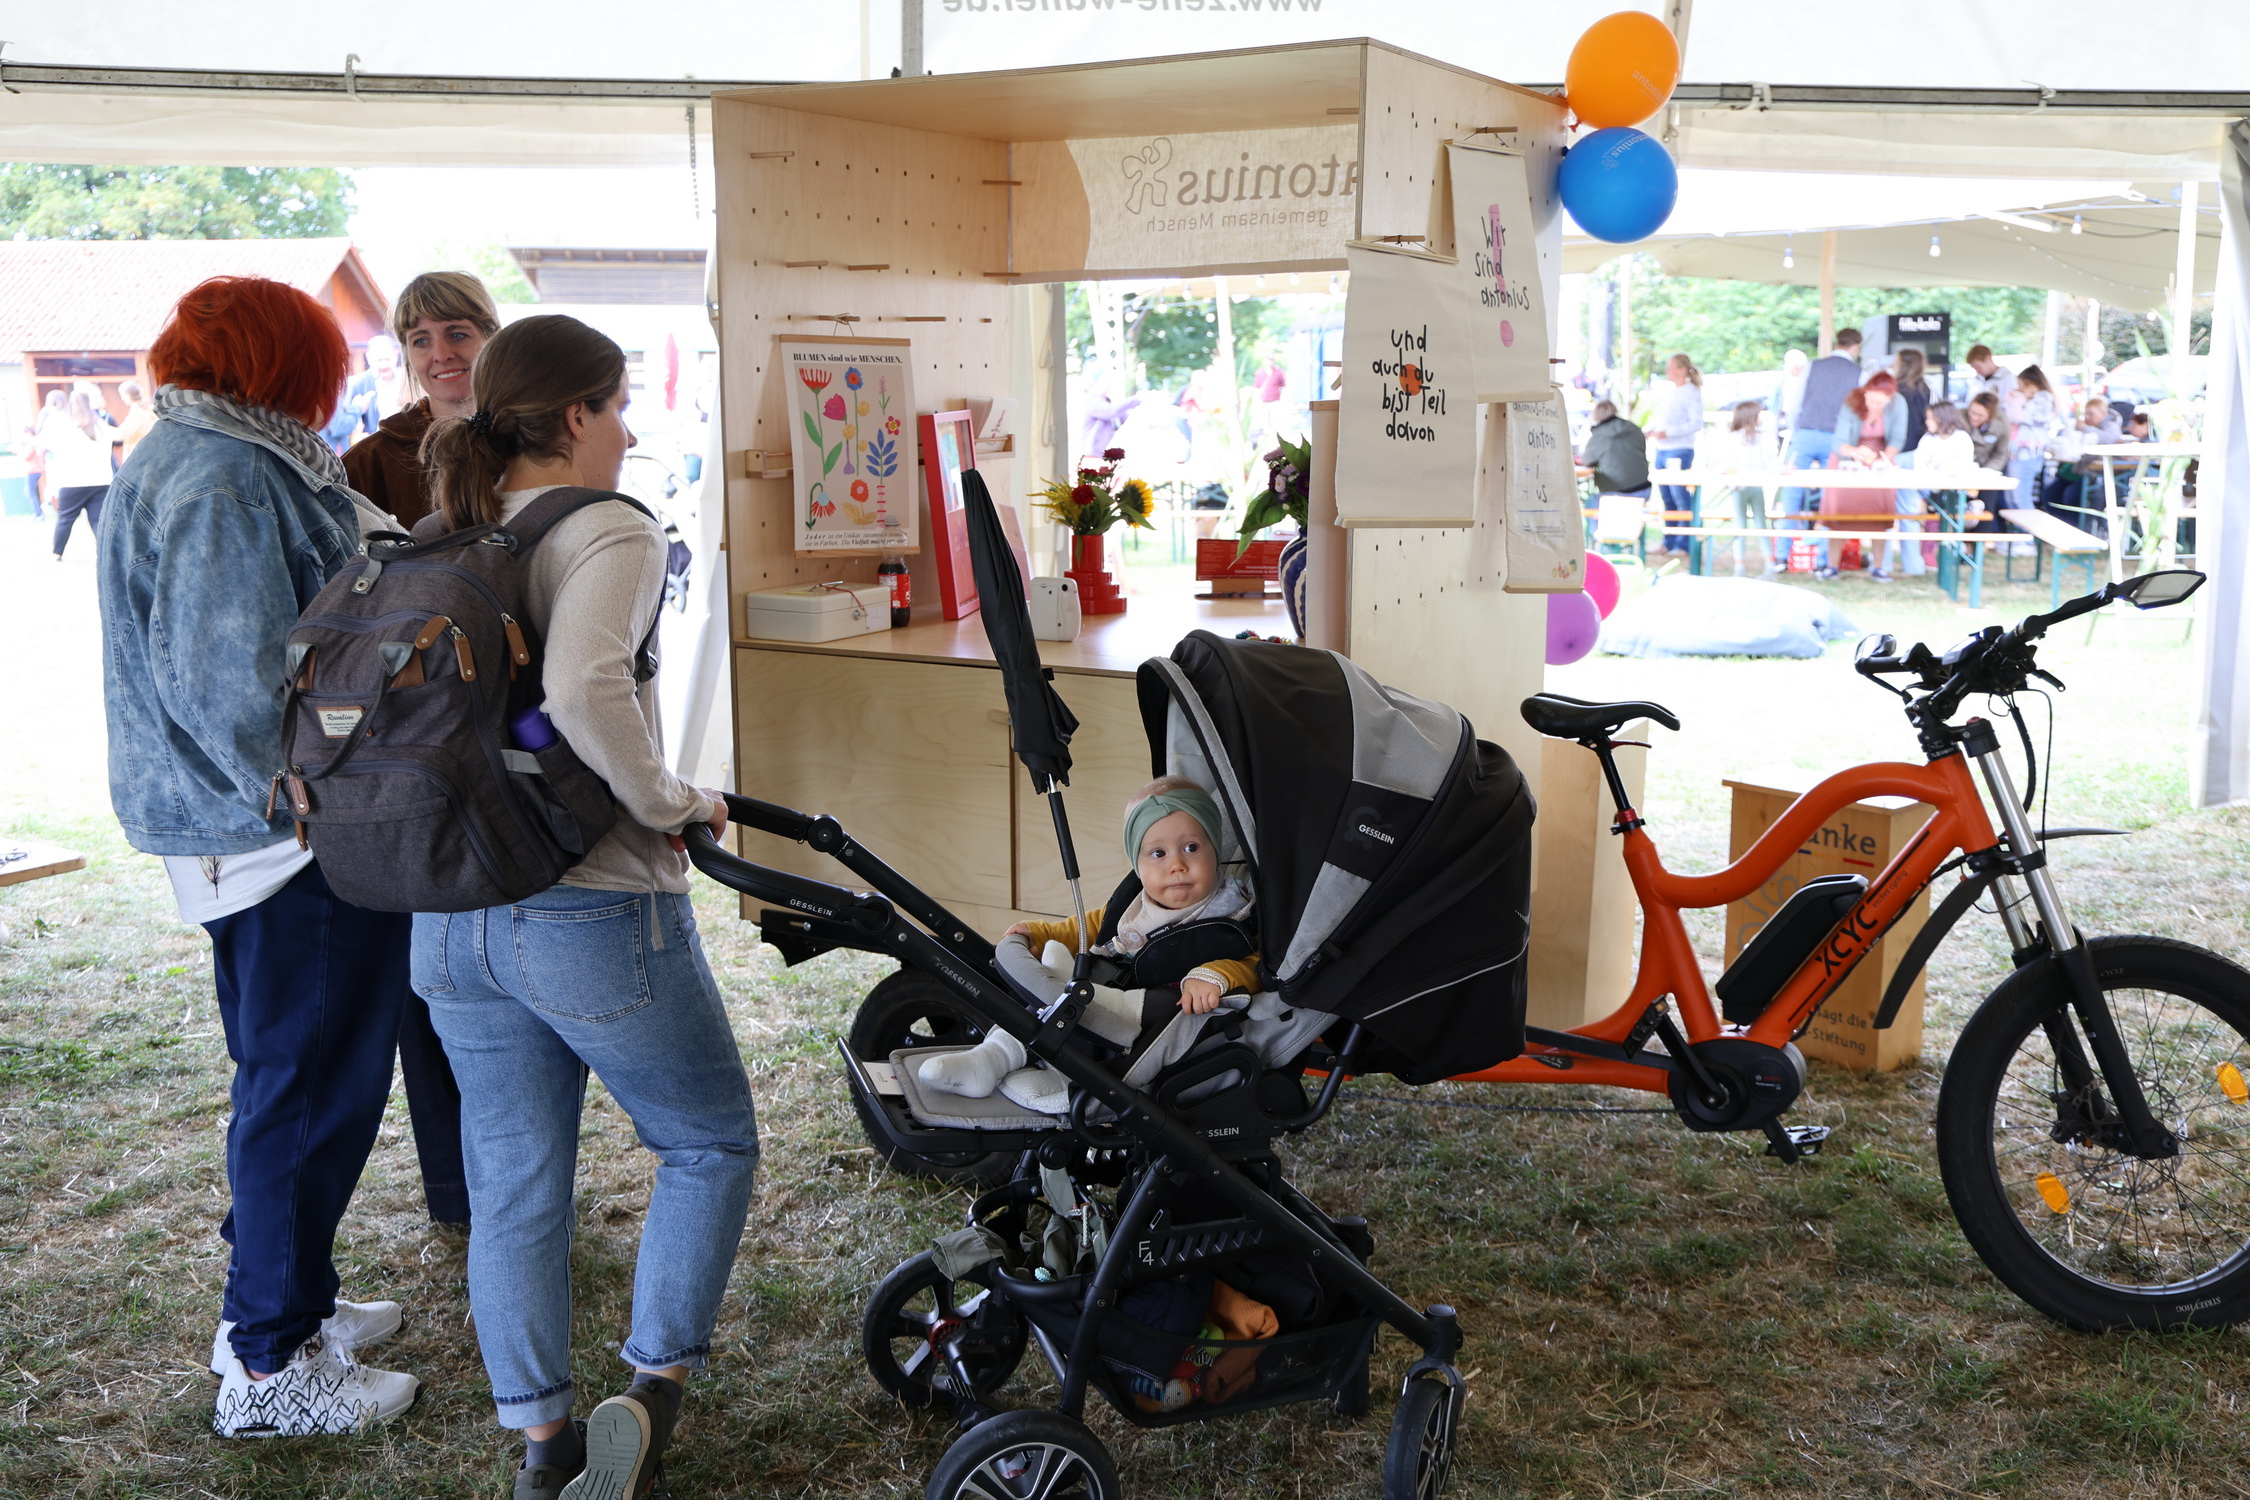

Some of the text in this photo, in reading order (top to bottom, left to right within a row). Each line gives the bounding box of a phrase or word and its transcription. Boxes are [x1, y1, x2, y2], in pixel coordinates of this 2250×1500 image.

[1481, 215, 1506, 249] Wir
[793, 353, 827, 361] BLUMEN
[827, 354, 843, 362] sind
[1372, 348, 1434, 383] auch du
[1382, 383, 1446, 415] bist Teil
[1386, 412, 1435, 442] davon
[1528, 425, 1556, 450] anton
[1359, 824, 1395, 845] GESSLEIN
[1808, 823, 1876, 855] nke
[789, 898, 833, 917] GESSLEIN
[1815, 905, 1878, 978] XCYC
[1847, 1013, 1867, 1029] die
[1207, 1127, 1239, 1138] SSLEIN
